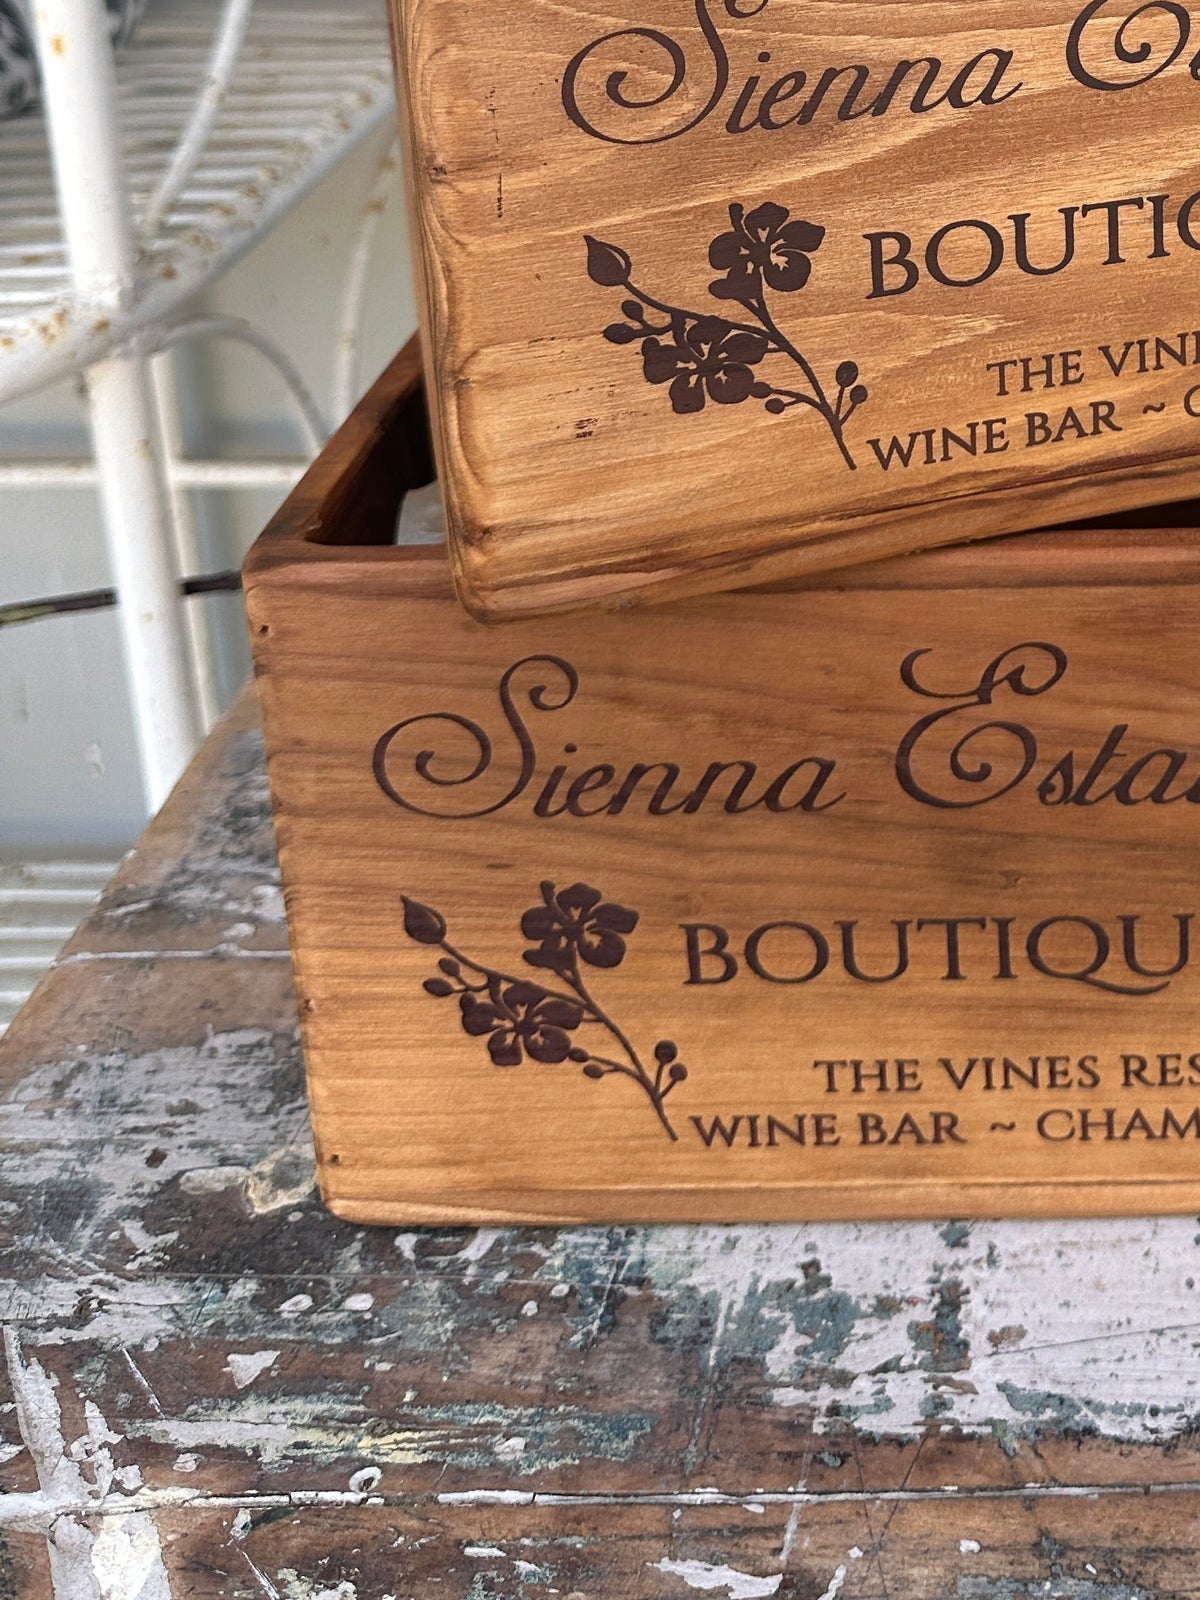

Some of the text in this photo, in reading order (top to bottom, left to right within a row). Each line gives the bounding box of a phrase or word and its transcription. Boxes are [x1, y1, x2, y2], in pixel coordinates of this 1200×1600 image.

[985, 351, 1087, 398] THE
[867, 416, 1009, 473] WINE
[1023, 401, 1120, 450] BAR
[370, 653, 847, 821] Sienna
[812, 1054, 927, 1095] THE
[940, 1052, 1103, 1094] VINES
[688, 1107, 849, 1149] WINE
[859, 1106, 963, 1148] BAR
